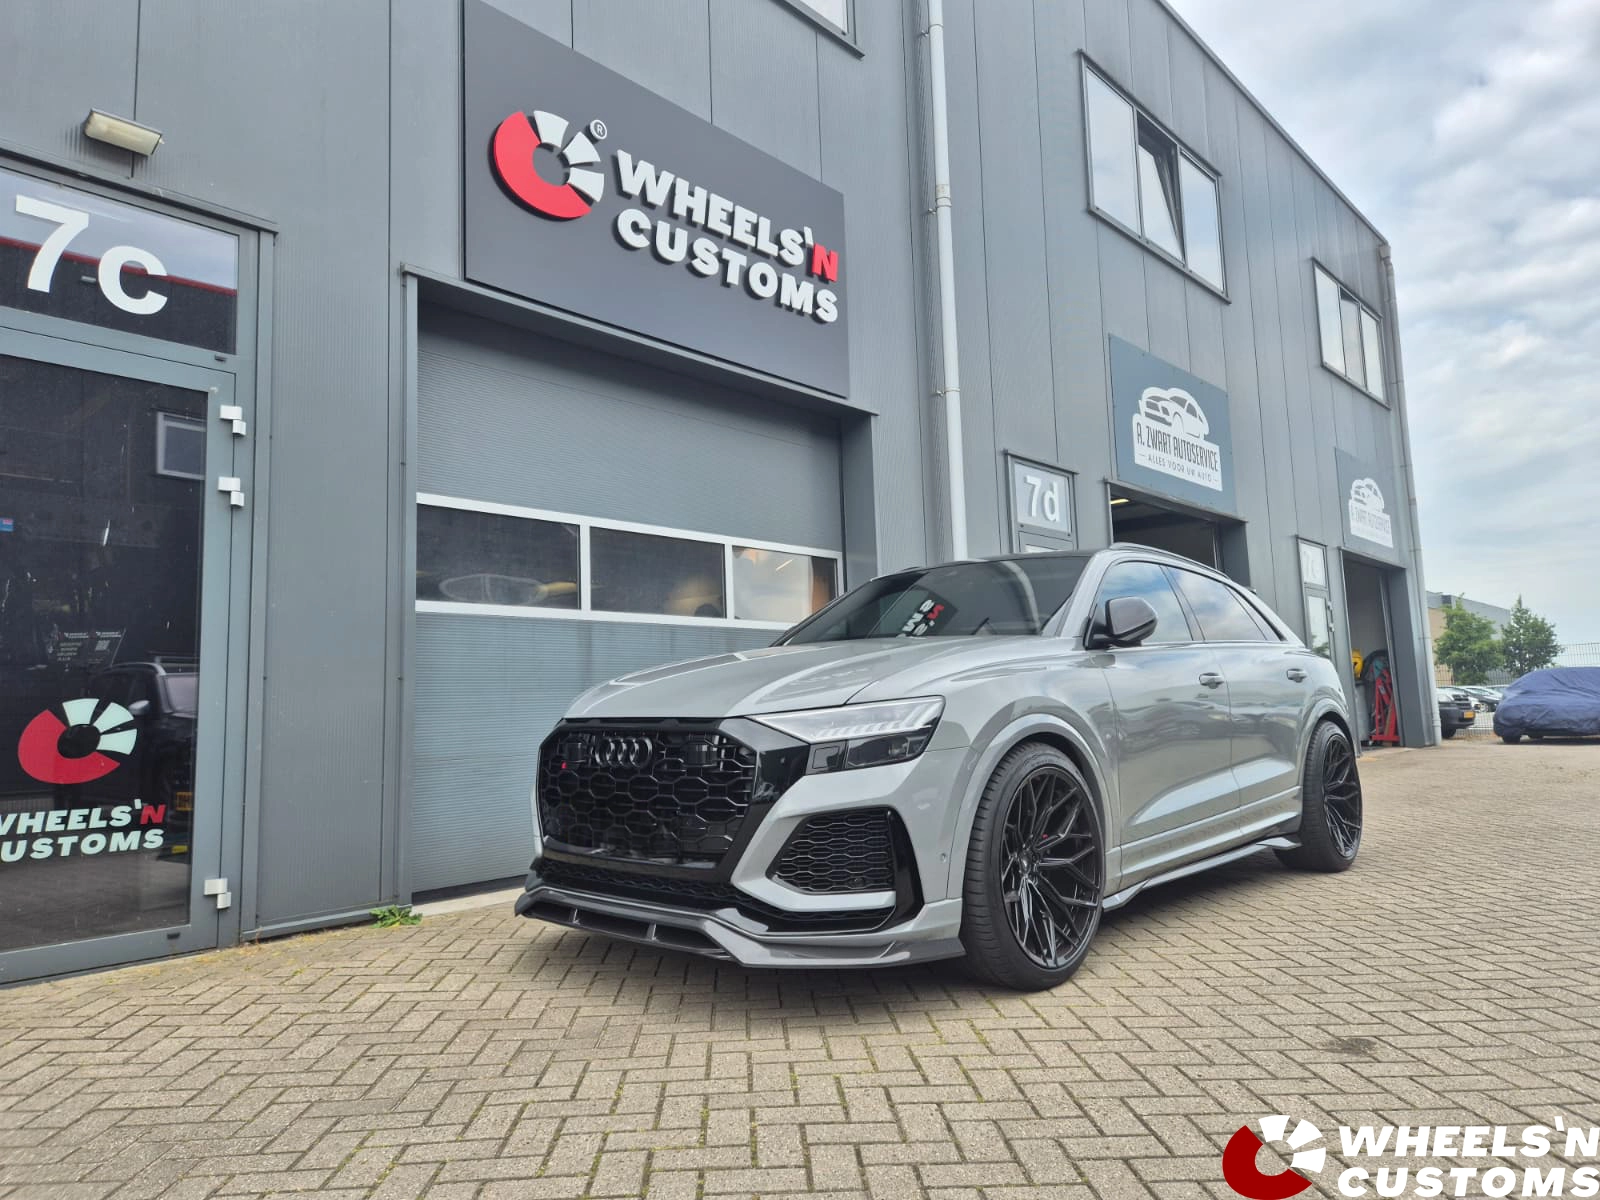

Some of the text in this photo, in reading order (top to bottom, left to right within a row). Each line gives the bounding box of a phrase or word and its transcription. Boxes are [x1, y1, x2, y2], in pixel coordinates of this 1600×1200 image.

[15, 194, 168, 315] 7c
[617, 149, 838, 282] WHEELS'N
[617, 208, 838, 323] CUSTOMS
[1146, 426, 1172, 454] ZWART
[1173, 437, 1218, 472] AUTOSERVICE
[1148, 455, 1165, 467] ALLES
[1169, 461, 1185, 472] VOOR
[1024, 474, 1061, 523] 7d
